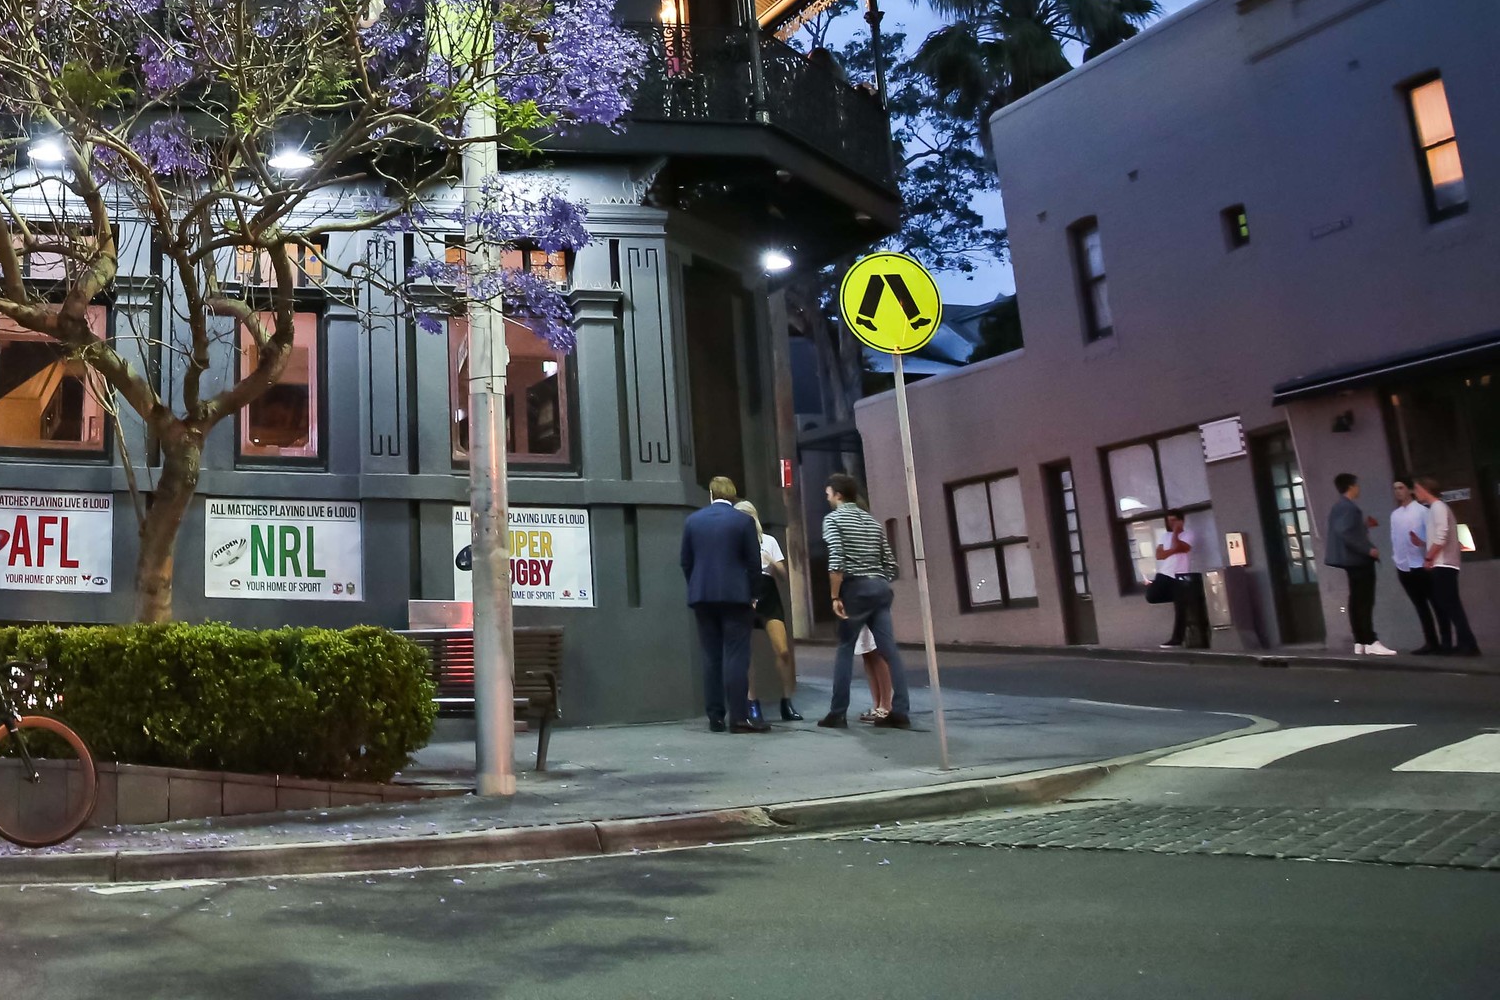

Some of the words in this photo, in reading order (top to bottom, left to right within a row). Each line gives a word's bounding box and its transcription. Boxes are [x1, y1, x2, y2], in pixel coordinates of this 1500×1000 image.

[30, 496, 63, 508] PLAYING
[64, 497, 81, 508] LIVE
[83, 498, 88, 508] &
[89, 498, 110, 509] LOUD
[210, 503, 226, 515] ALL
[227, 504, 268, 516] MATCHES
[269, 505, 305, 517] PLAYING
[306, 505, 325, 517] LIVE
[327, 506, 333, 518] &
[334, 506, 357, 518] LOUD
[455, 511, 469, 521] ALL
[508, 513, 539, 524] PLAYING
[540, 513, 557, 524] LIVE
[559, 514, 564, 524] &
[565, 514, 585, 525] LOUD
[8, 515, 79, 568] AFL
[214, 539, 238, 558] STEEDEN
[509, 531, 553, 557] PER
[250, 524, 326, 578] NRL
[5, 573, 25, 584] YOUR
[25, 574, 44, 584] HOME
[46, 575, 56, 585] OF
[56, 575, 78, 585] SPORT
[510, 559, 553, 586] GBY
[246, 581, 266, 591] YOUR
[266, 581, 287, 592] HOME
[288, 582, 298, 592] OF
[298, 582, 321, 593] SPORT
[512, 591, 525, 599] OME
[527, 591, 534, 599] OF
[536, 591, 555, 600] SPORT
